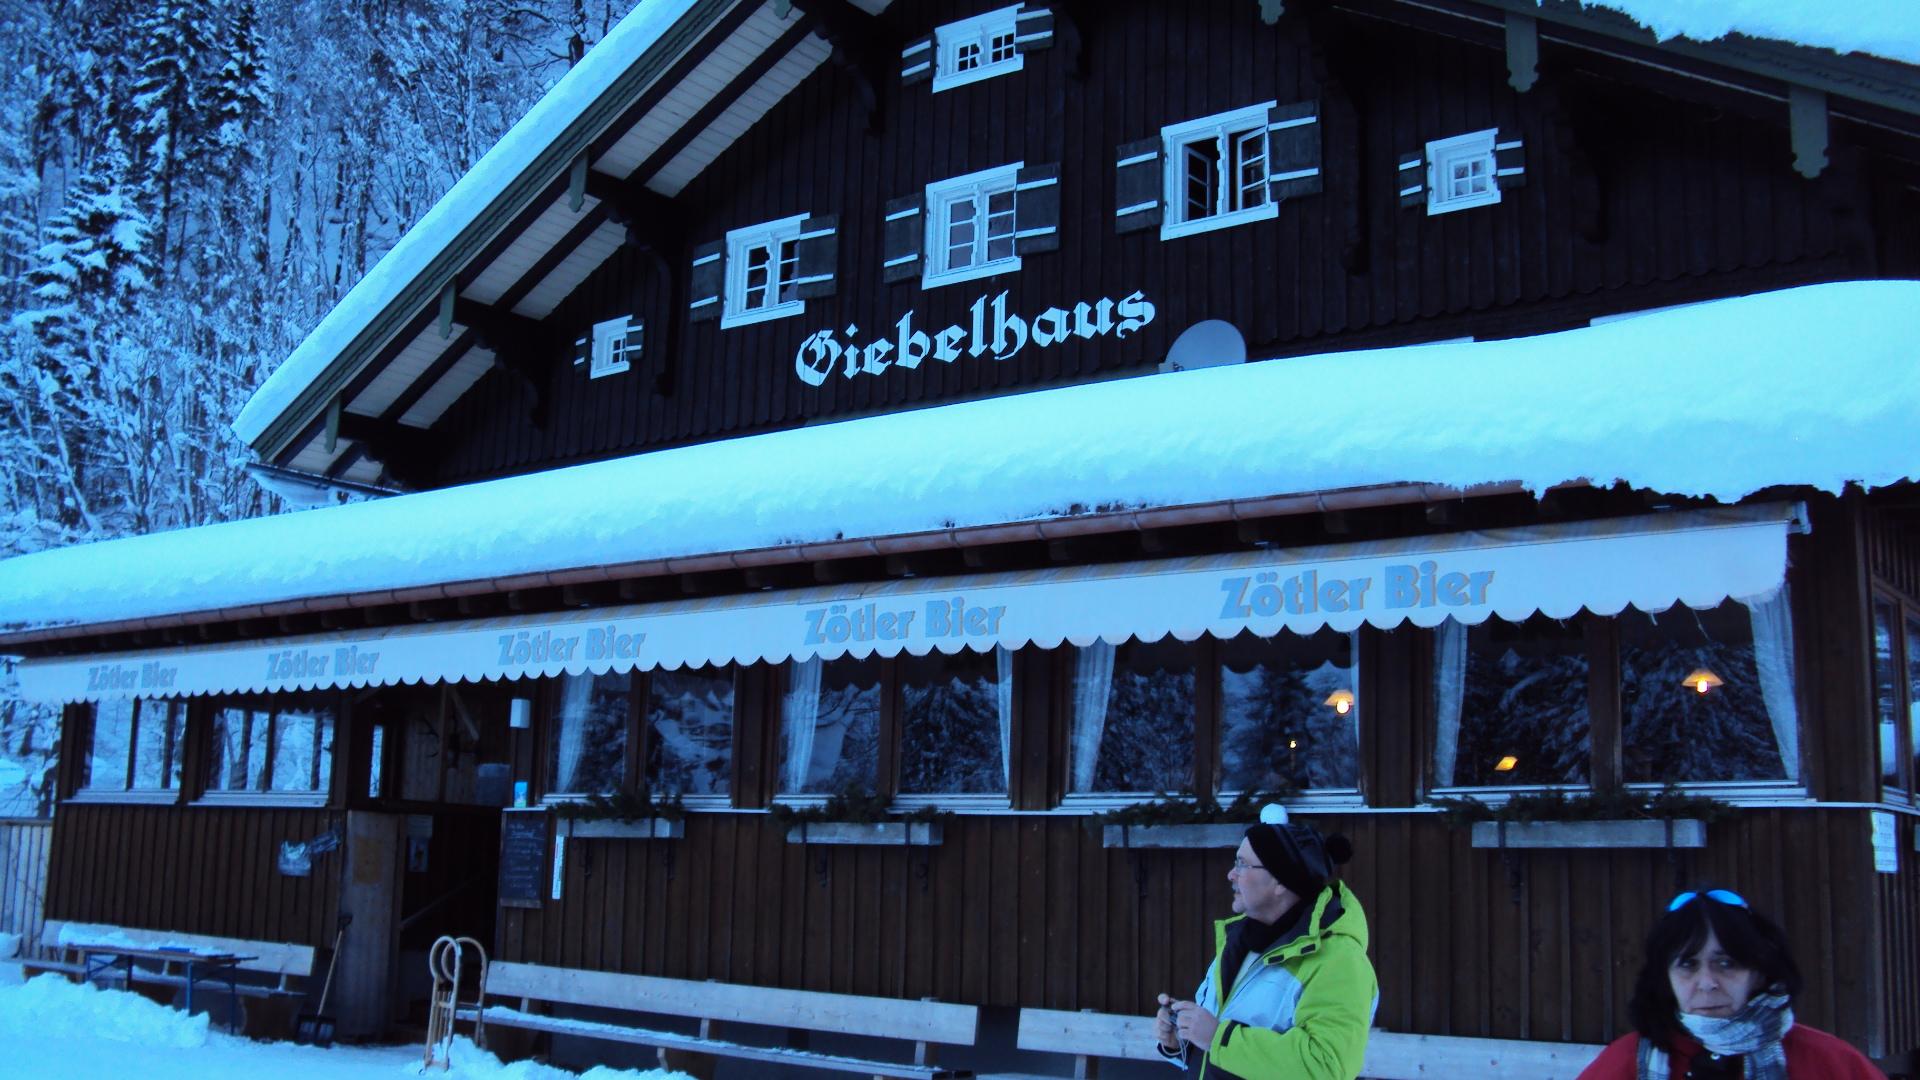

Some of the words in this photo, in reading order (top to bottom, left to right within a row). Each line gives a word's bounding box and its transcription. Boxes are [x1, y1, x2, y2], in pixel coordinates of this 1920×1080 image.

[795, 289, 1156, 387] Giebelhaus
[1219, 569, 1372, 619] Zötler
[1385, 560, 1495, 609] Bier
[804, 603, 916, 645] Zötler
[925, 596, 1006, 638] Bier
[266, 649, 330, 680] Zötler
[333, 645, 380, 676] Bier
[498, 630, 580, 666] Zötler
[585, 624, 647, 660] Bier
[87, 663, 138, 692] Zötler
[141, 661, 177, 688] Bier
